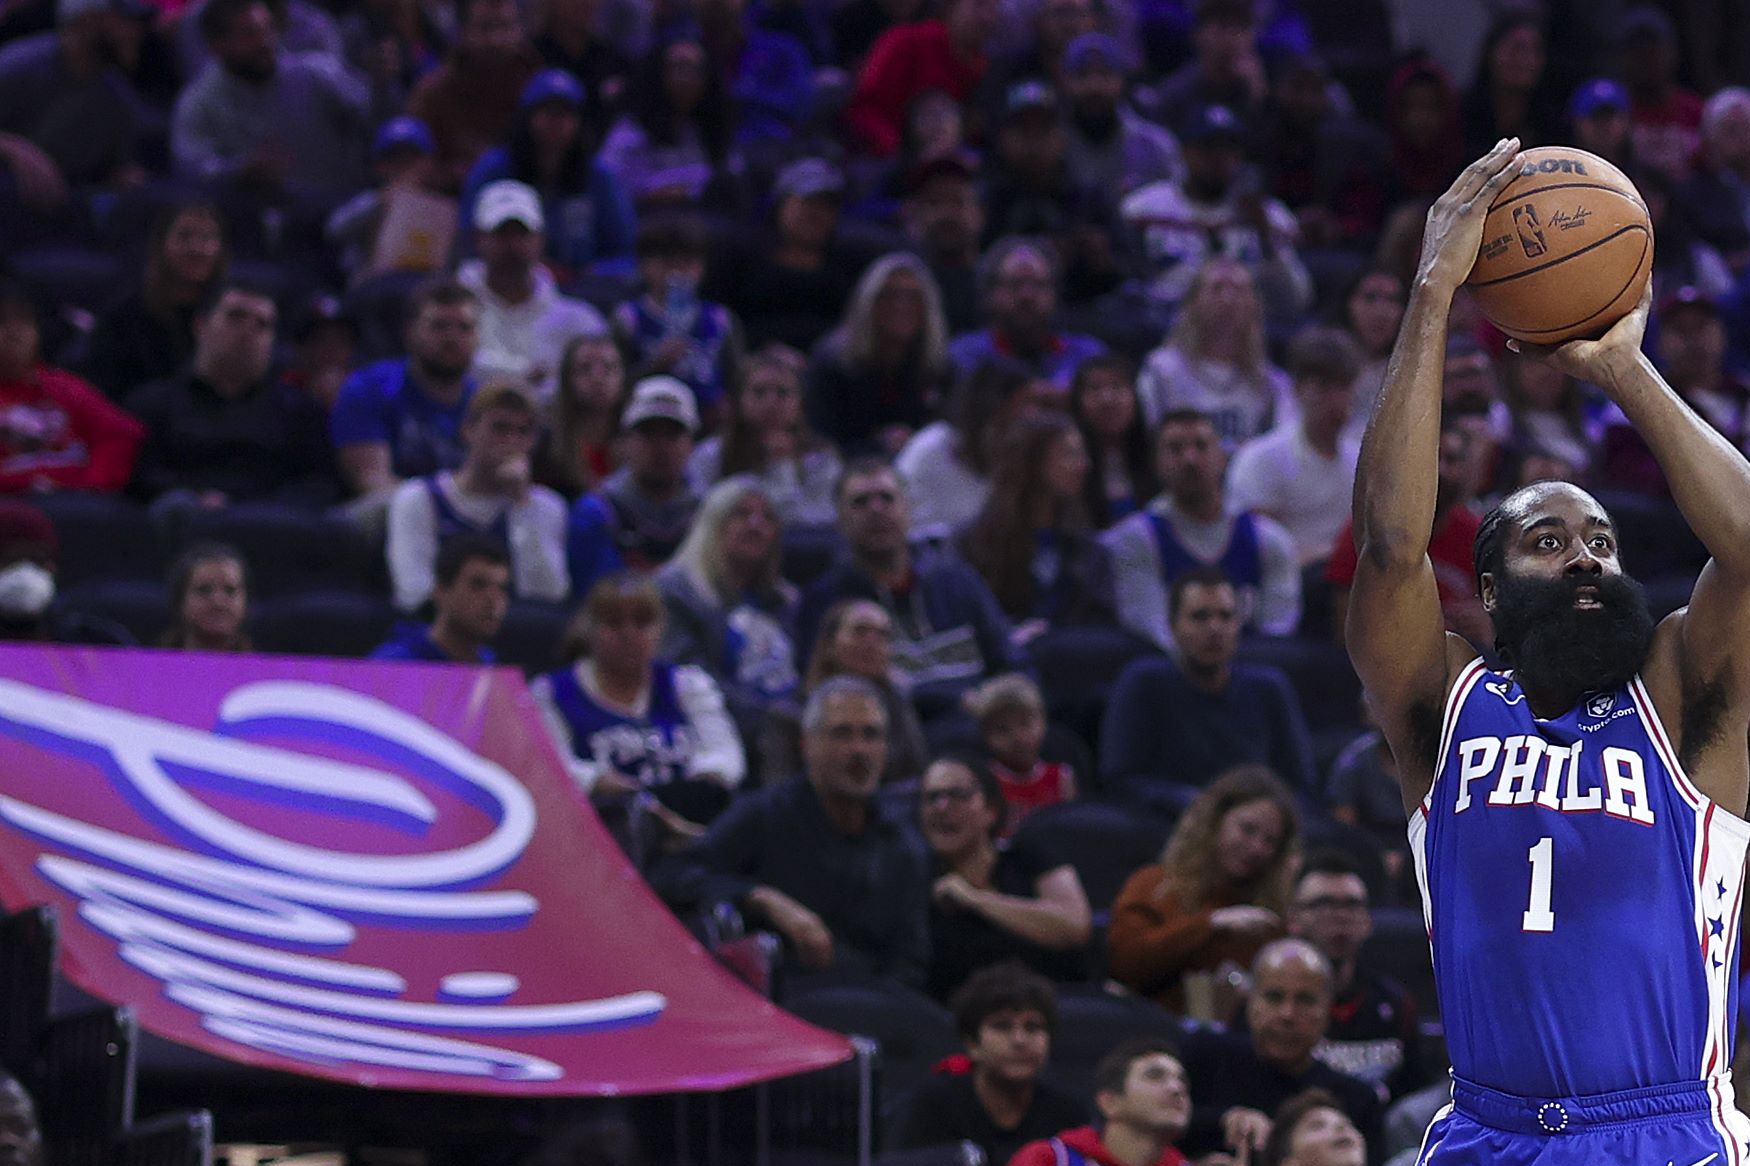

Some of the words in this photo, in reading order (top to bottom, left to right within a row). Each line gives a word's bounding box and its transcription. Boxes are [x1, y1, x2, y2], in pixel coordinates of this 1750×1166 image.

[1578, 707, 1636, 733] crypto.com
[1454, 735, 1656, 828] PHILA
[1521, 837, 1555, 933] 1
